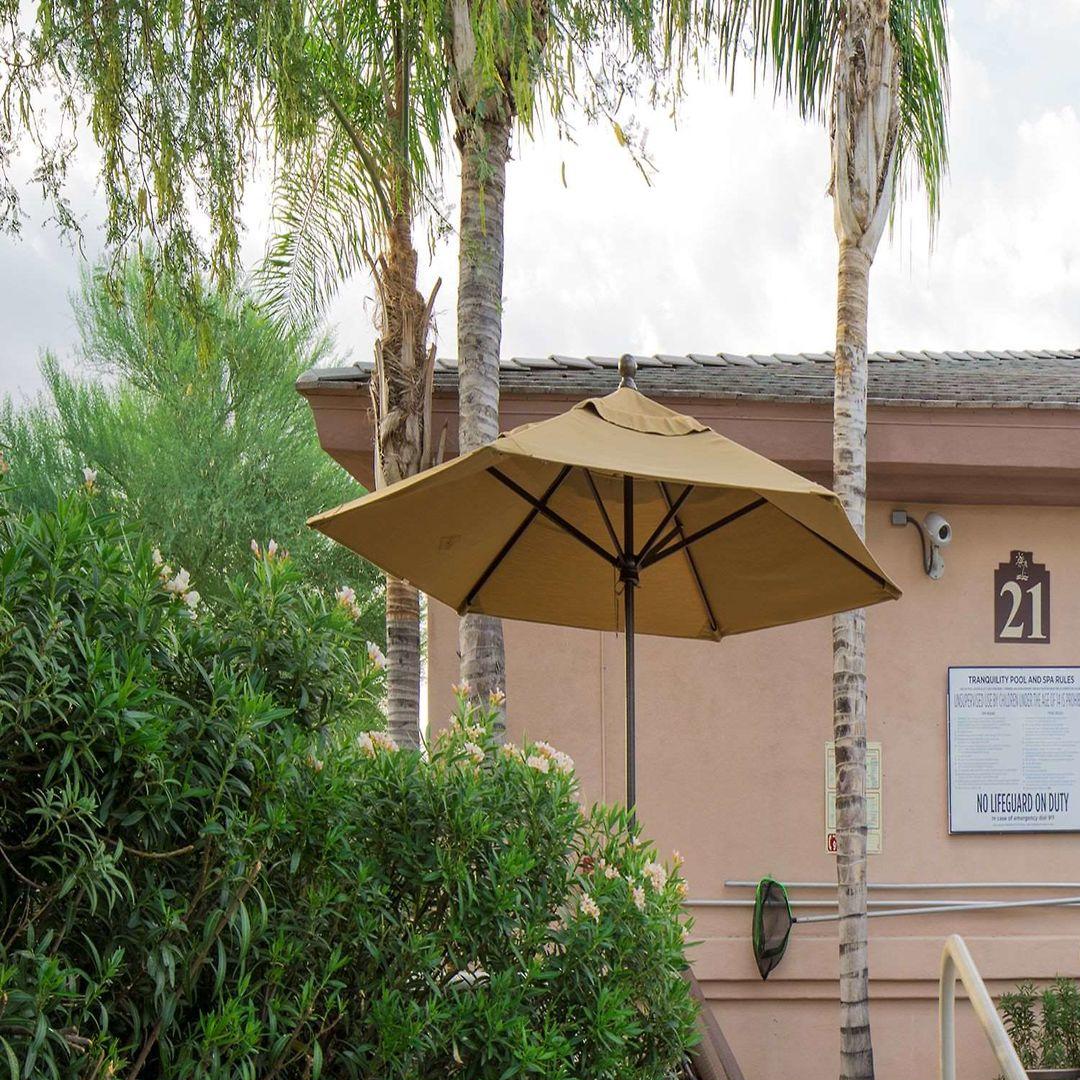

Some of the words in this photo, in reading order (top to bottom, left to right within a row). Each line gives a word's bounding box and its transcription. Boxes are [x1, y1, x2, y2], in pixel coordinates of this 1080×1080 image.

[999, 580, 1047, 639] 21
[968, 675, 1009, 684] TRANQUILITY
[1010, 675, 1027, 684] POOL
[1028, 675, 1042, 684] AND
[1043, 675, 1054, 684] SPA
[1055, 675, 1075, 684] RULES
[976, 793, 988, 813] NO
[991, 792, 1033, 812] LIFEGUARD
[1035, 792, 1047, 812] ON
[1049, 792, 1070, 812] DUTY
